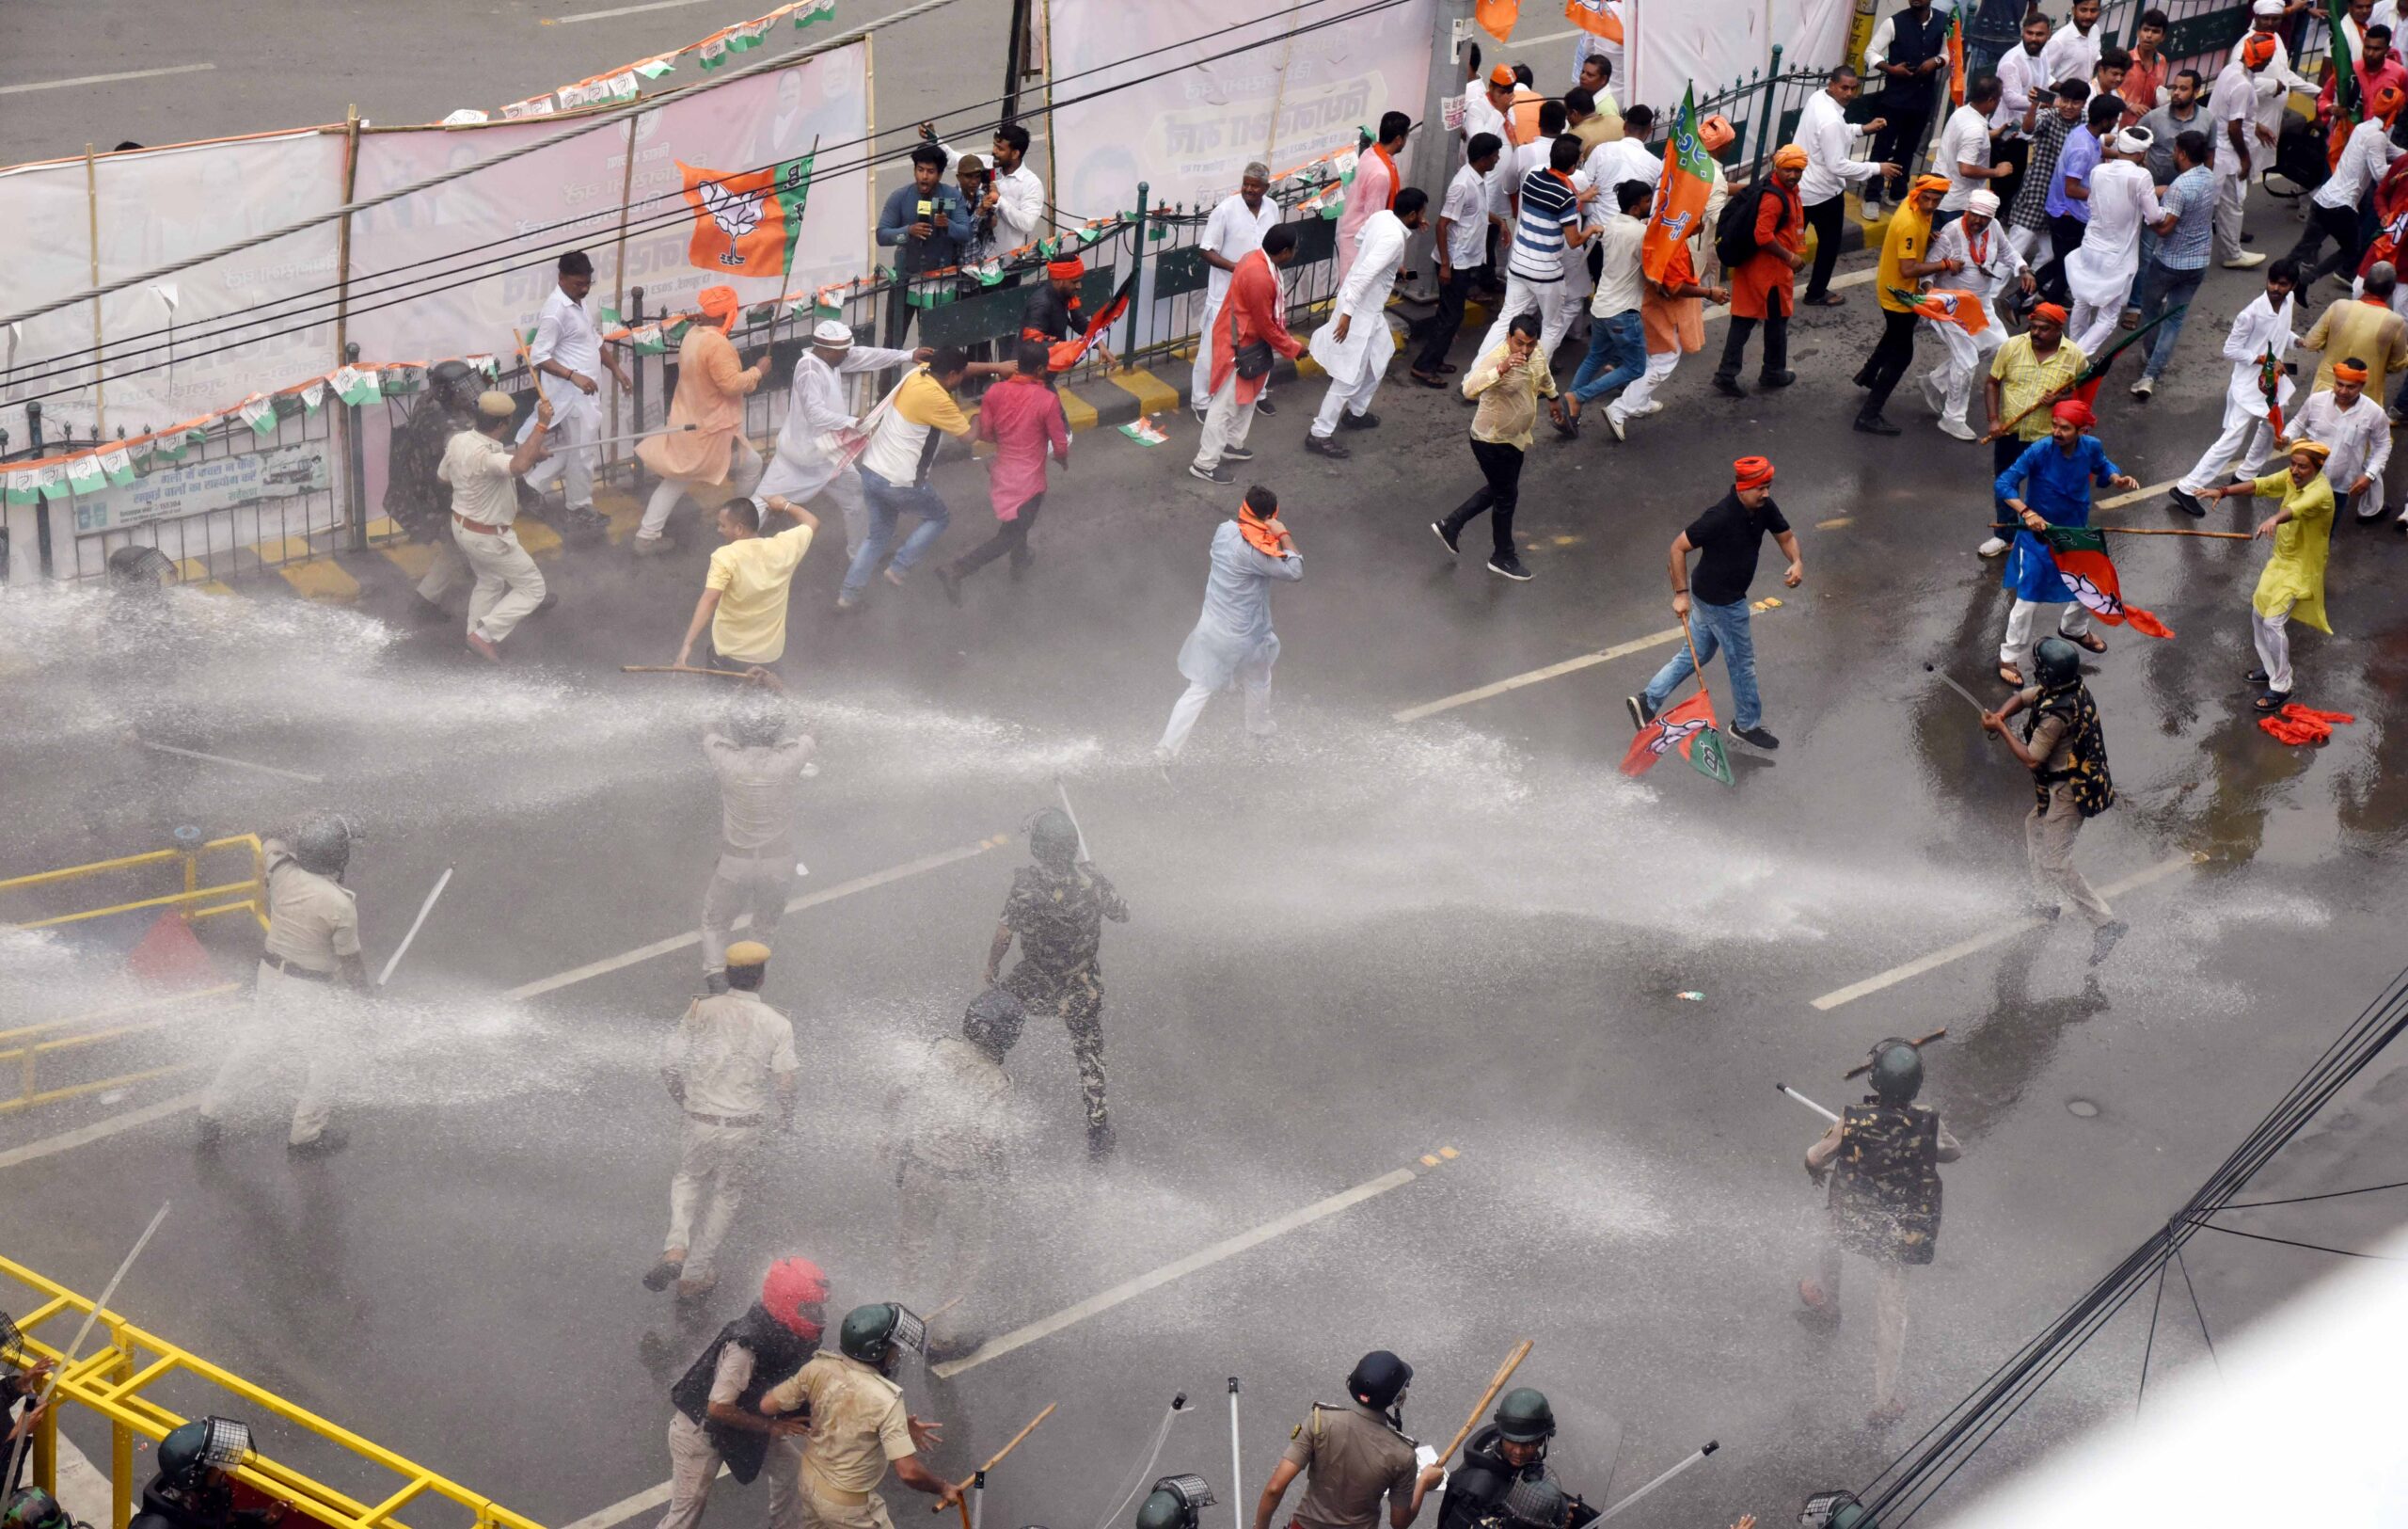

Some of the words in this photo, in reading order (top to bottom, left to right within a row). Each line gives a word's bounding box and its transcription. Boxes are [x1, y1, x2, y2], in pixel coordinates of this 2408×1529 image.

[1905, 237, 1913, 250] 3
[225, 464, 234, 473] न
[188, 483, 202, 493] का
